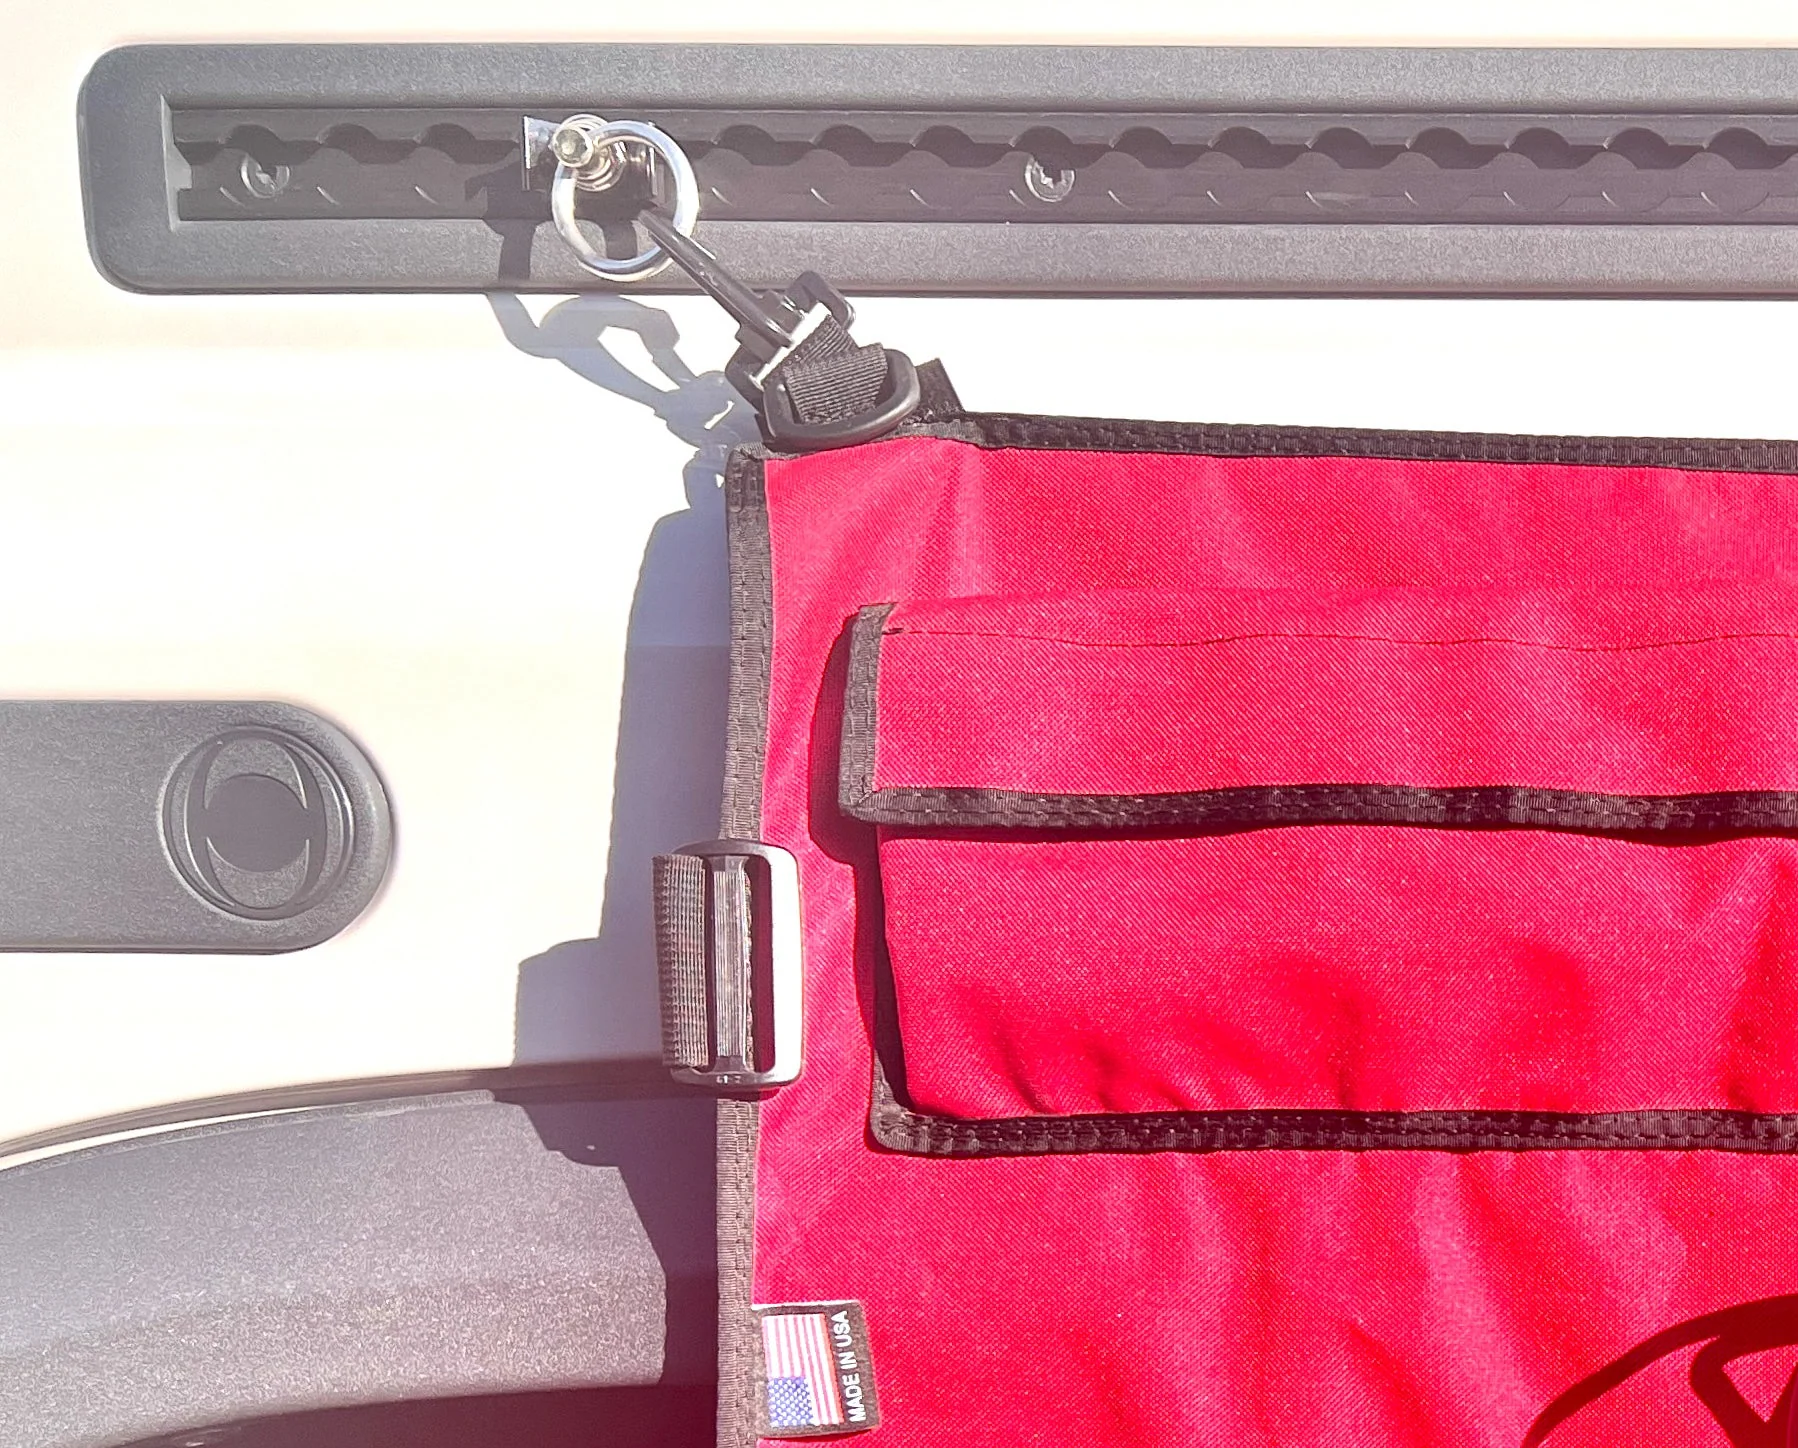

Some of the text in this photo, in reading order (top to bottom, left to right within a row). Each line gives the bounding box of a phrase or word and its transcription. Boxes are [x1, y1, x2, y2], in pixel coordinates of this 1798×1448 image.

[831, 1310, 867, 1422] MADE IN USA
